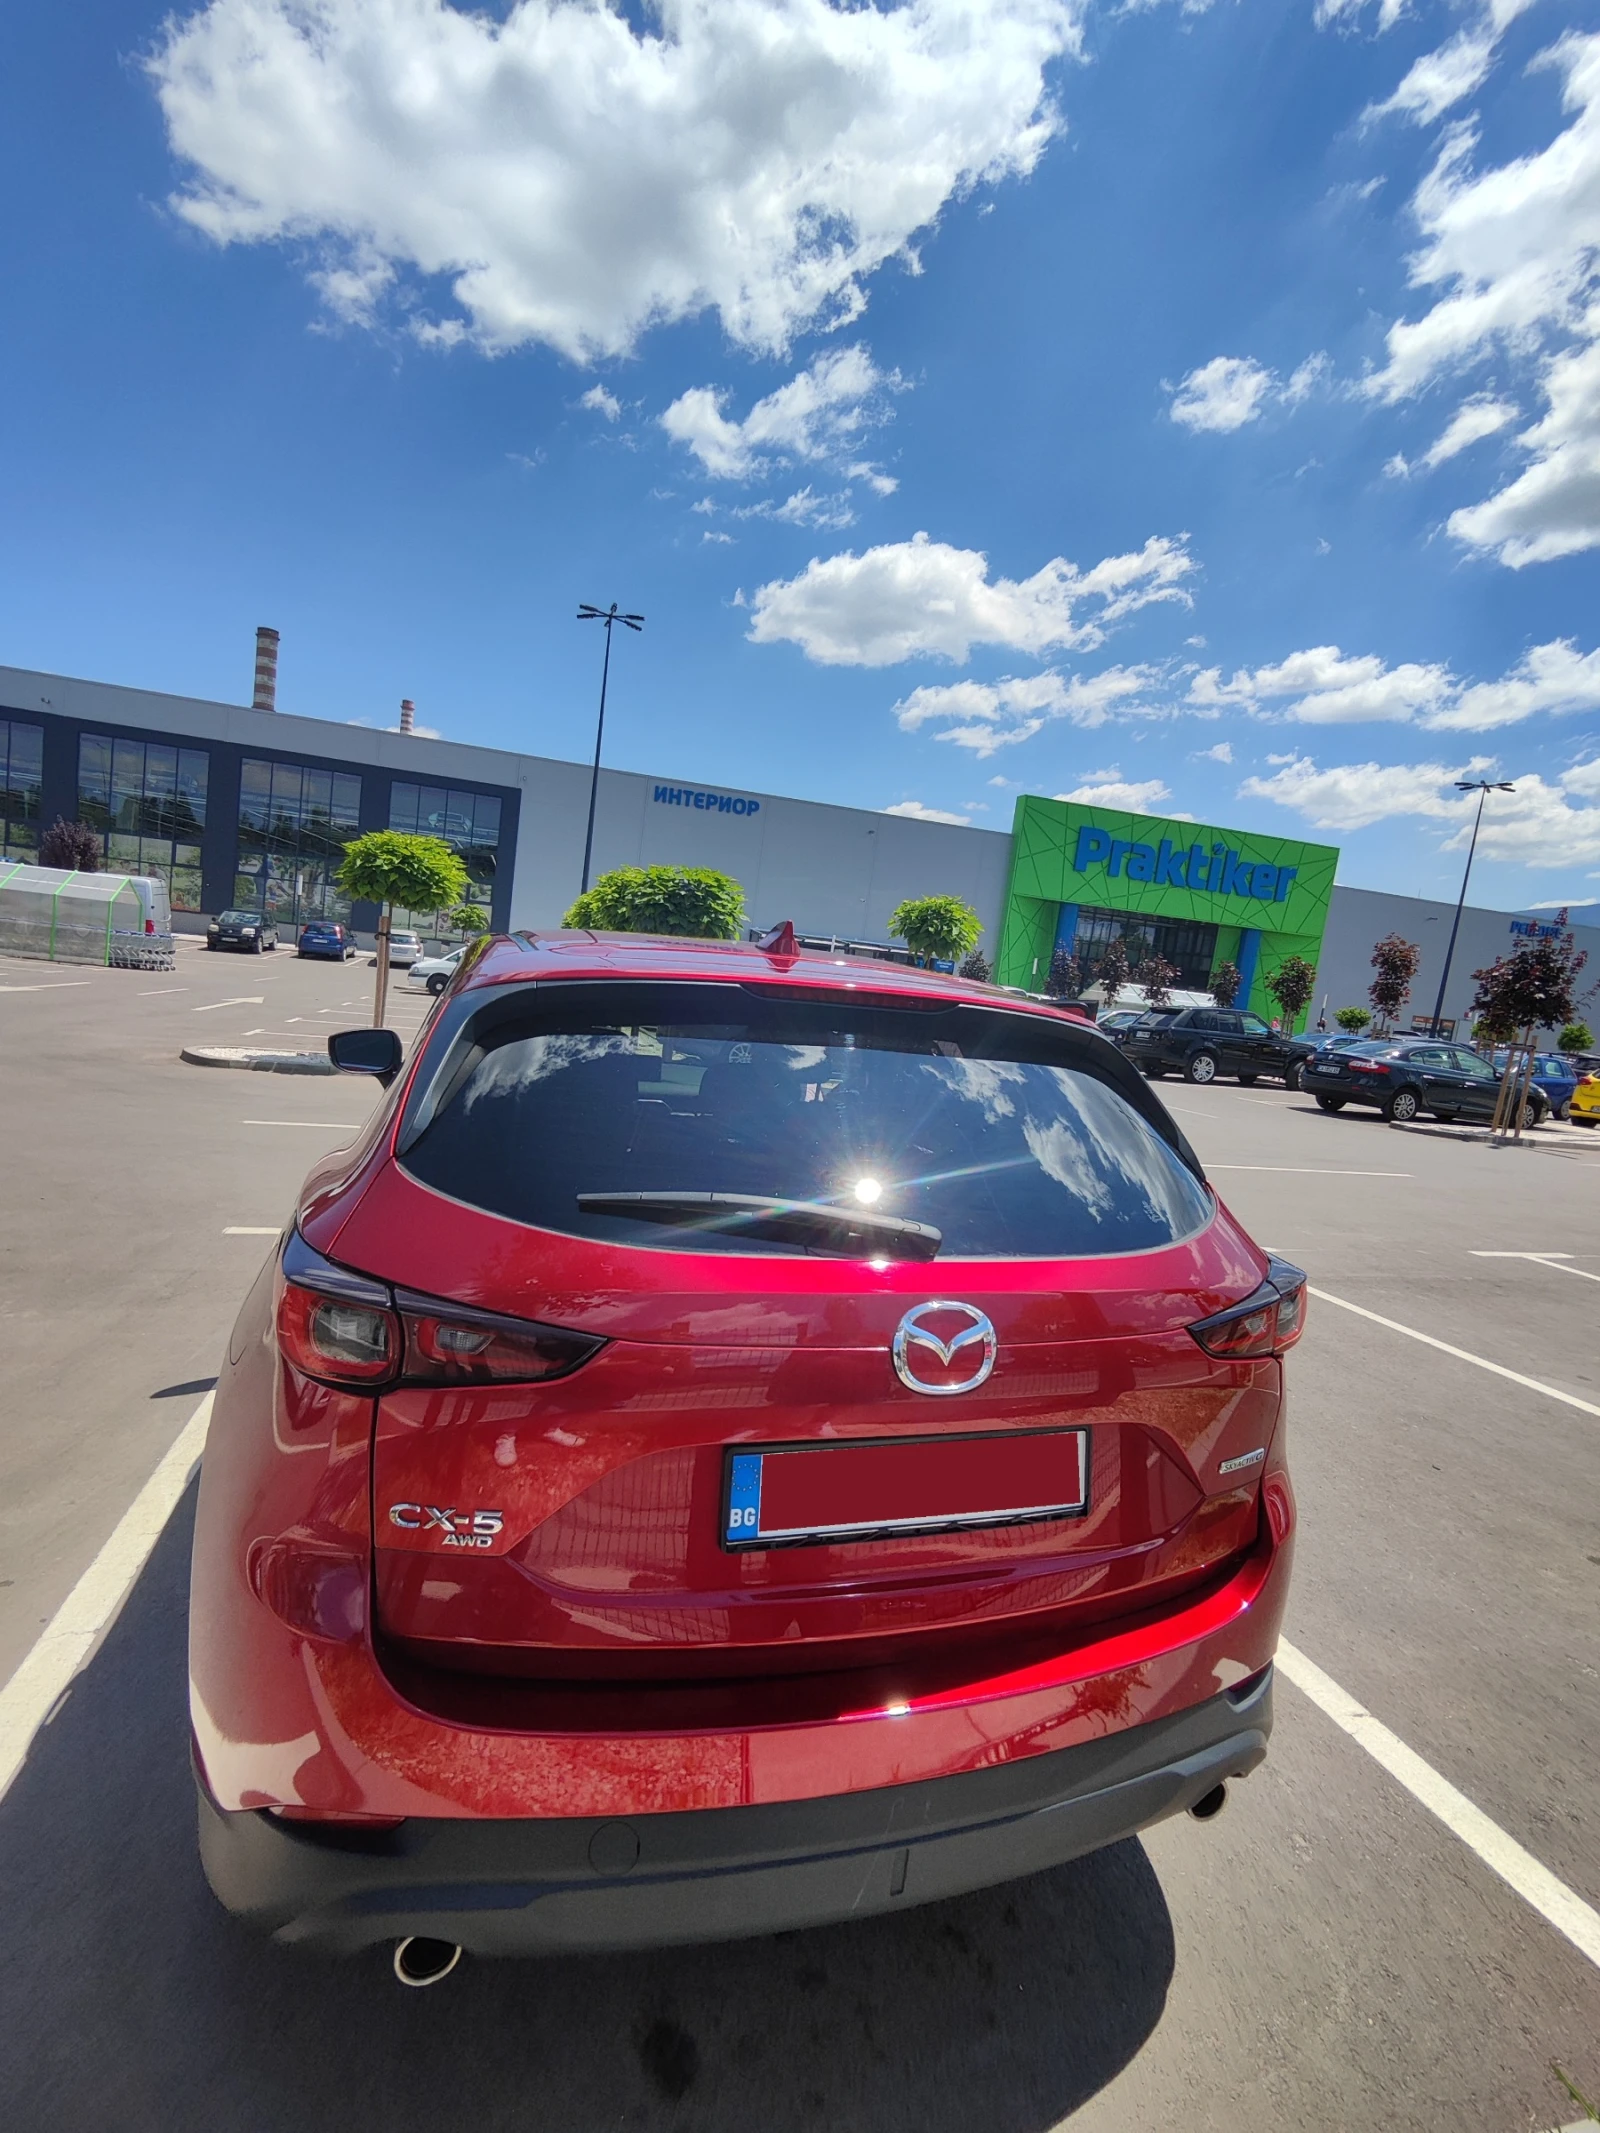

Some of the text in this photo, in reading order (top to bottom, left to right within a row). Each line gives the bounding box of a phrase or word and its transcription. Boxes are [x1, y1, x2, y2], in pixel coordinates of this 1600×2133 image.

[654, 785, 760, 816] ИНТЕРИОР
[1073, 825, 1298, 902] Praktiker
[389, 1503, 504, 1534] CX-5
[730, 1507, 756, 1527] BG
[442, 1533, 493, 1548] AWD
